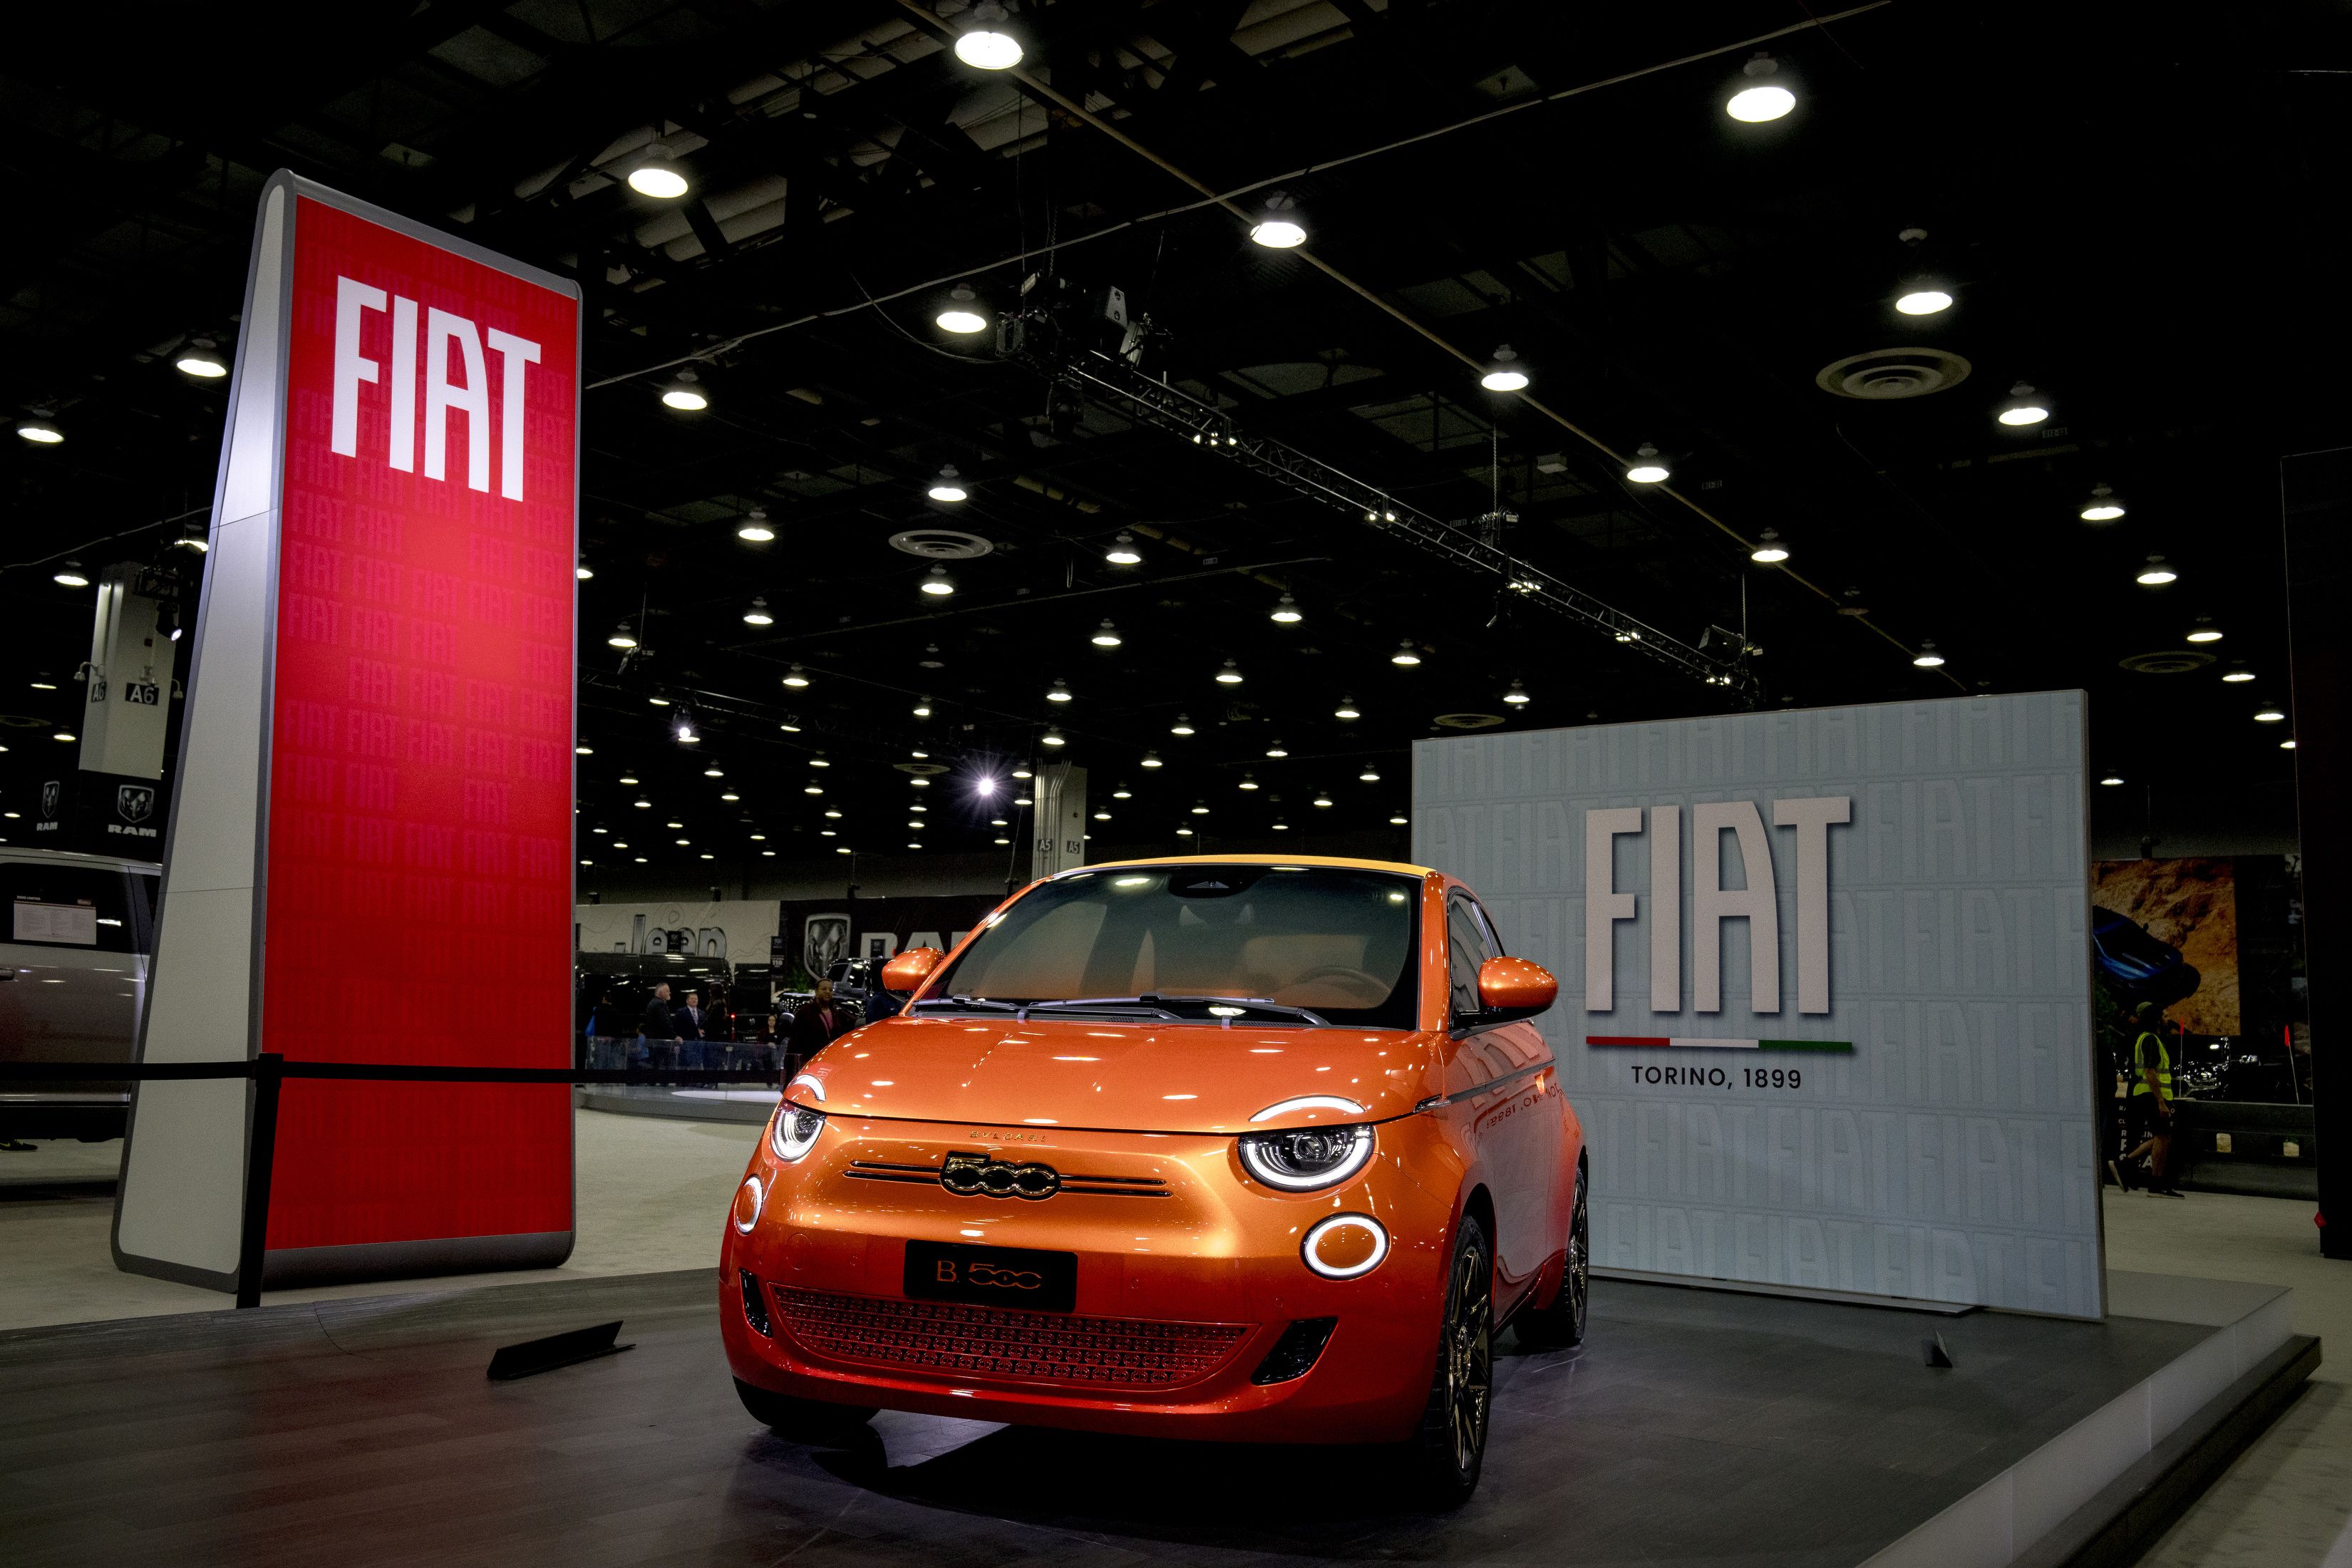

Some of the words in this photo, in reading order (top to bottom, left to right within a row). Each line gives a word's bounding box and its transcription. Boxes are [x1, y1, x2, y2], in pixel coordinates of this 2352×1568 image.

[331, 275, 541, 502] FIAT
[130, 685, 155, 704] A6
[36, 821, 58, 831] RAM
[108, 824, 157, 837] RAM
[1867, 776, 2004, 879] FIAT
[1039, 840, 1051, 851] A5
[1068, 842, 1080, 853] A5
[1586, 796, 1850, 1013] FIAT
[1904, 887, 2046, 989] FIAT
[1870, 1001, 2010, 1103] FIAT
[1631, 1066, 1732, 1089] TORINO,
[1744, 1068, 1801, 1088] 1899
[944, 1156, 1056, 1195] 500
[1636, 1101, 1758, 1203] FIAT
[1768, 1107, 1899, 1214] FIAT
[1908, 1113, 2051, 1224] FIAT
[936, 1260, 958, 1282] B
[968, 1262, 1043, 1289] 500
